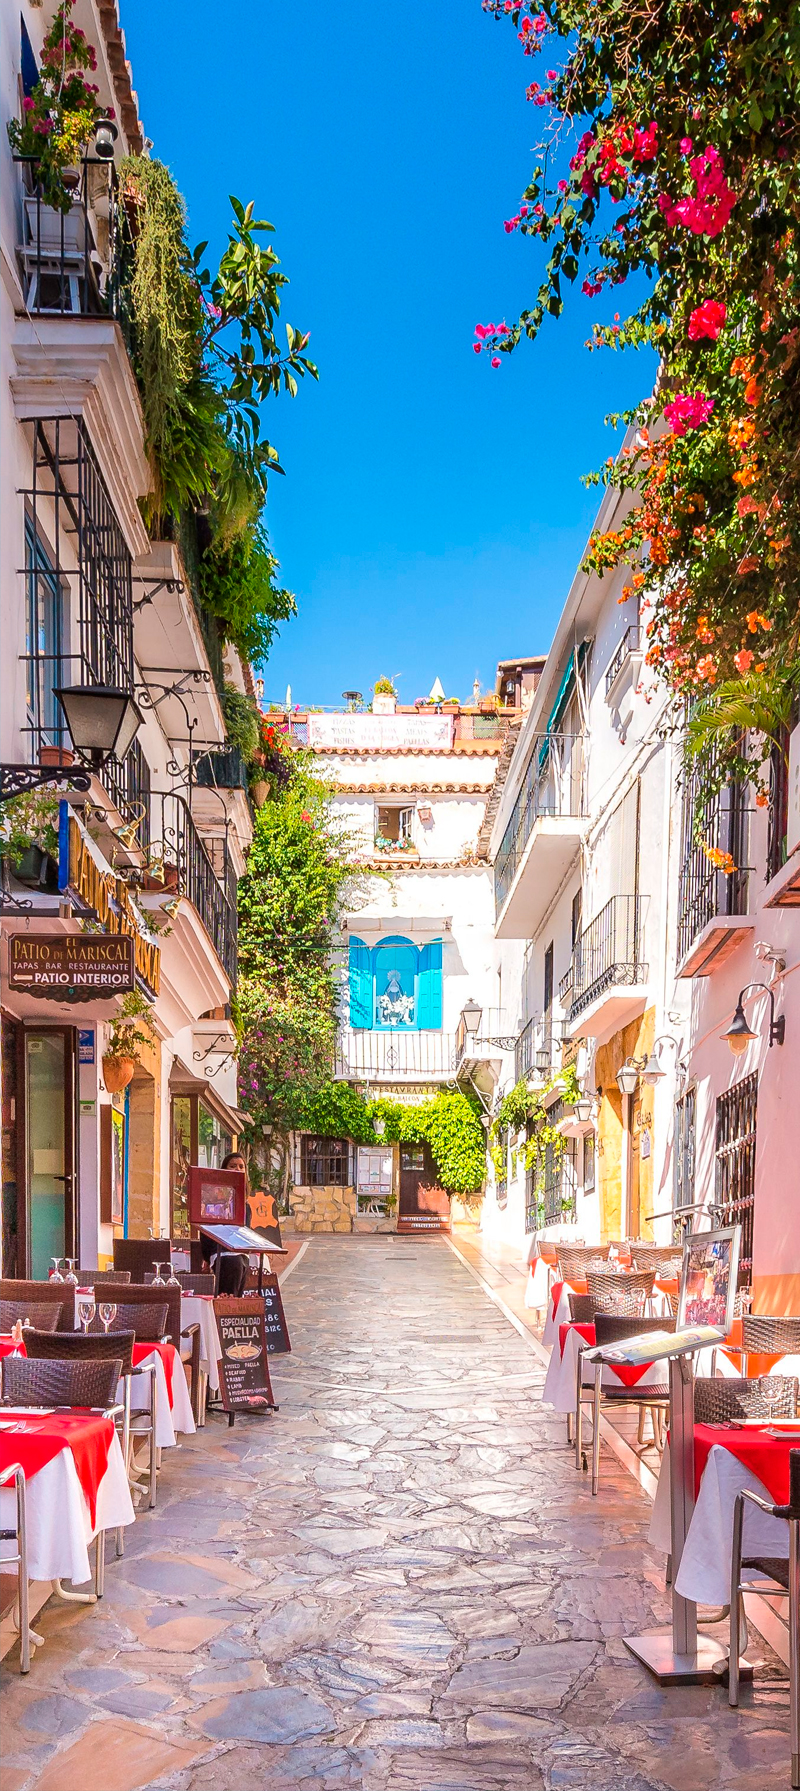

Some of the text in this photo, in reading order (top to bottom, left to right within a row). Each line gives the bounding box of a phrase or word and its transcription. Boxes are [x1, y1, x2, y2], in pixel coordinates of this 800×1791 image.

[66, 937, 77, 946] EL
[14, 939, 130, 961] PATIO DE MARISCAL
[13, 961, 129, 971] TAPAS BAR RESTAURANTE
[35, 972, 130, 984] PATIO INTERIOR
[220, 1316, 261, 1327] ESPECIALIDAD
[222, 1326, 260, 1339] PAELLA
